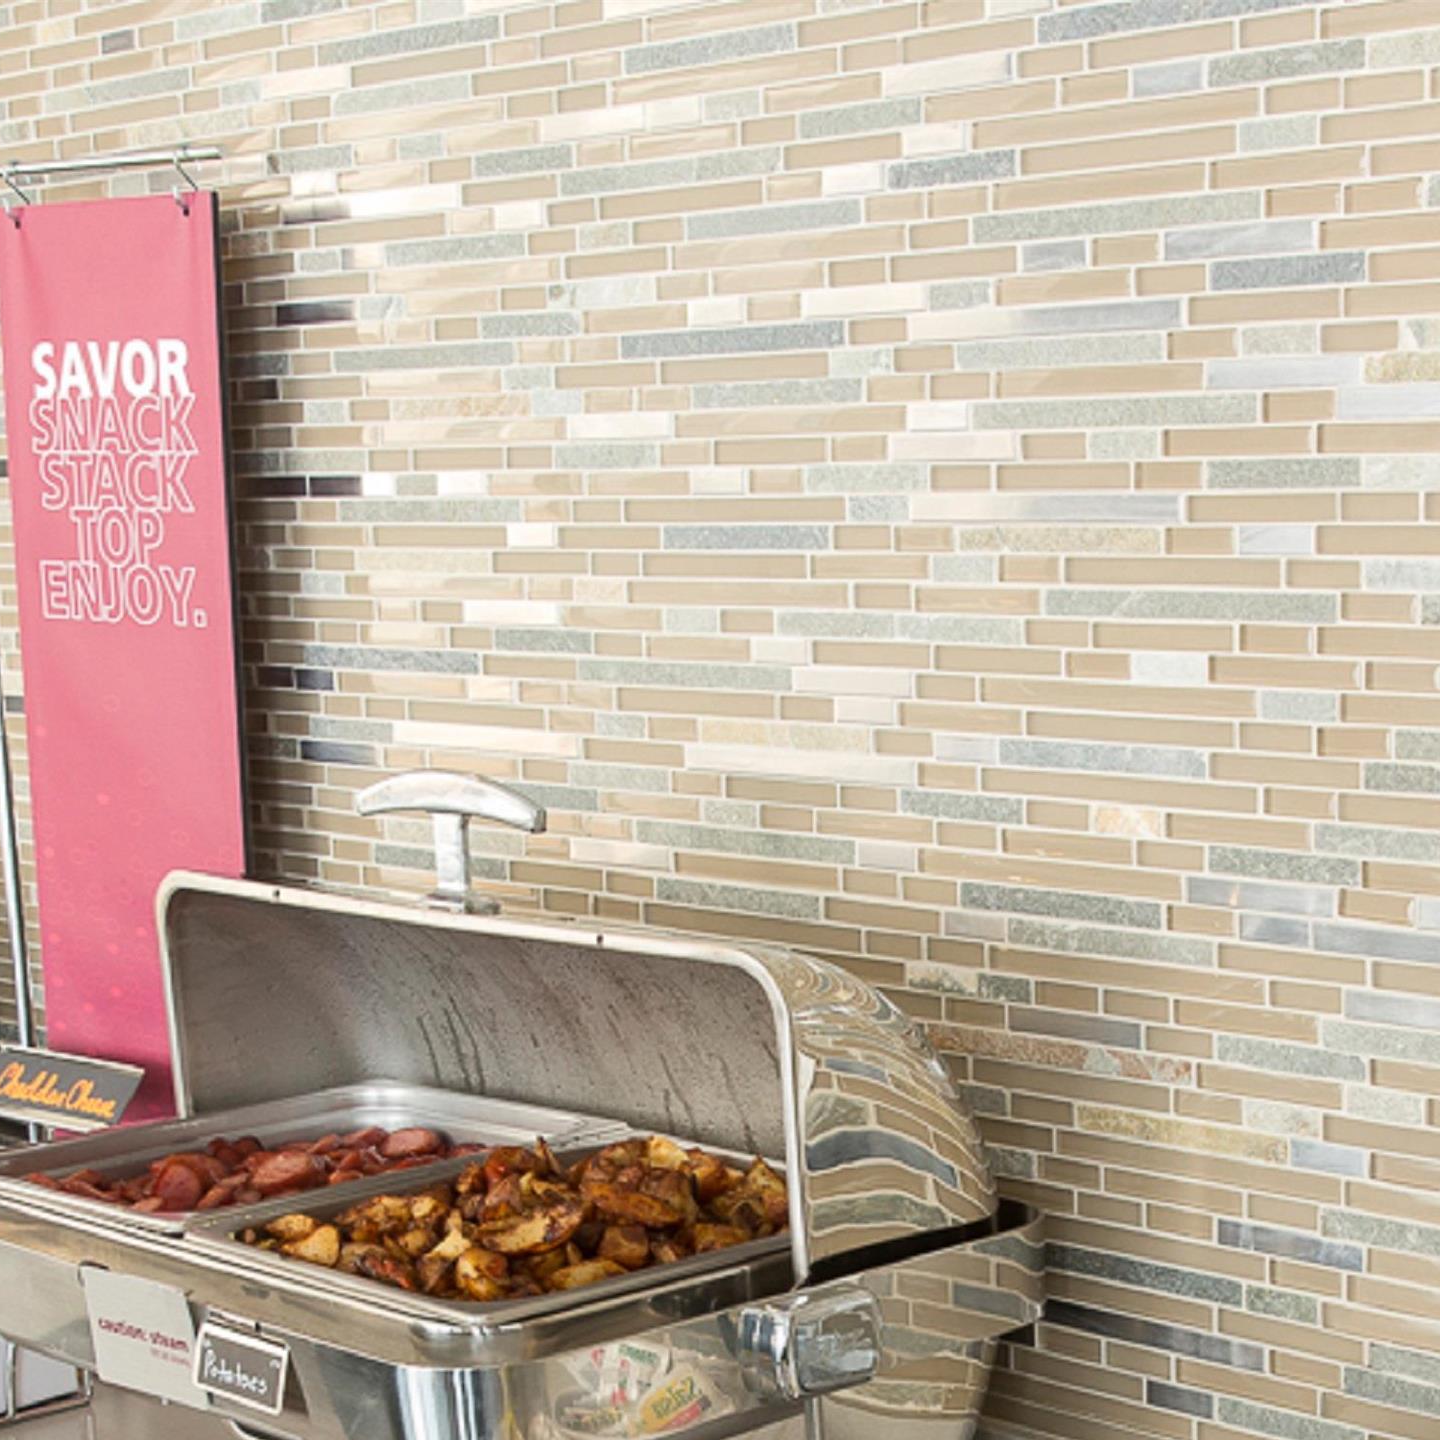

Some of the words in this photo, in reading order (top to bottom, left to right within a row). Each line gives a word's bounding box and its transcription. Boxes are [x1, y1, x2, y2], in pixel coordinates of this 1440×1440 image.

[31, 338, 191, 398] SAVOR
[29, 393, 198, 454] SNACK
[39, 450, 195, 512] STACK
[69, 506, 163, 567] TOP
[39, 559, 208, 626] ENJOY.
[204, 1348, 268, 1395] Potatoes
